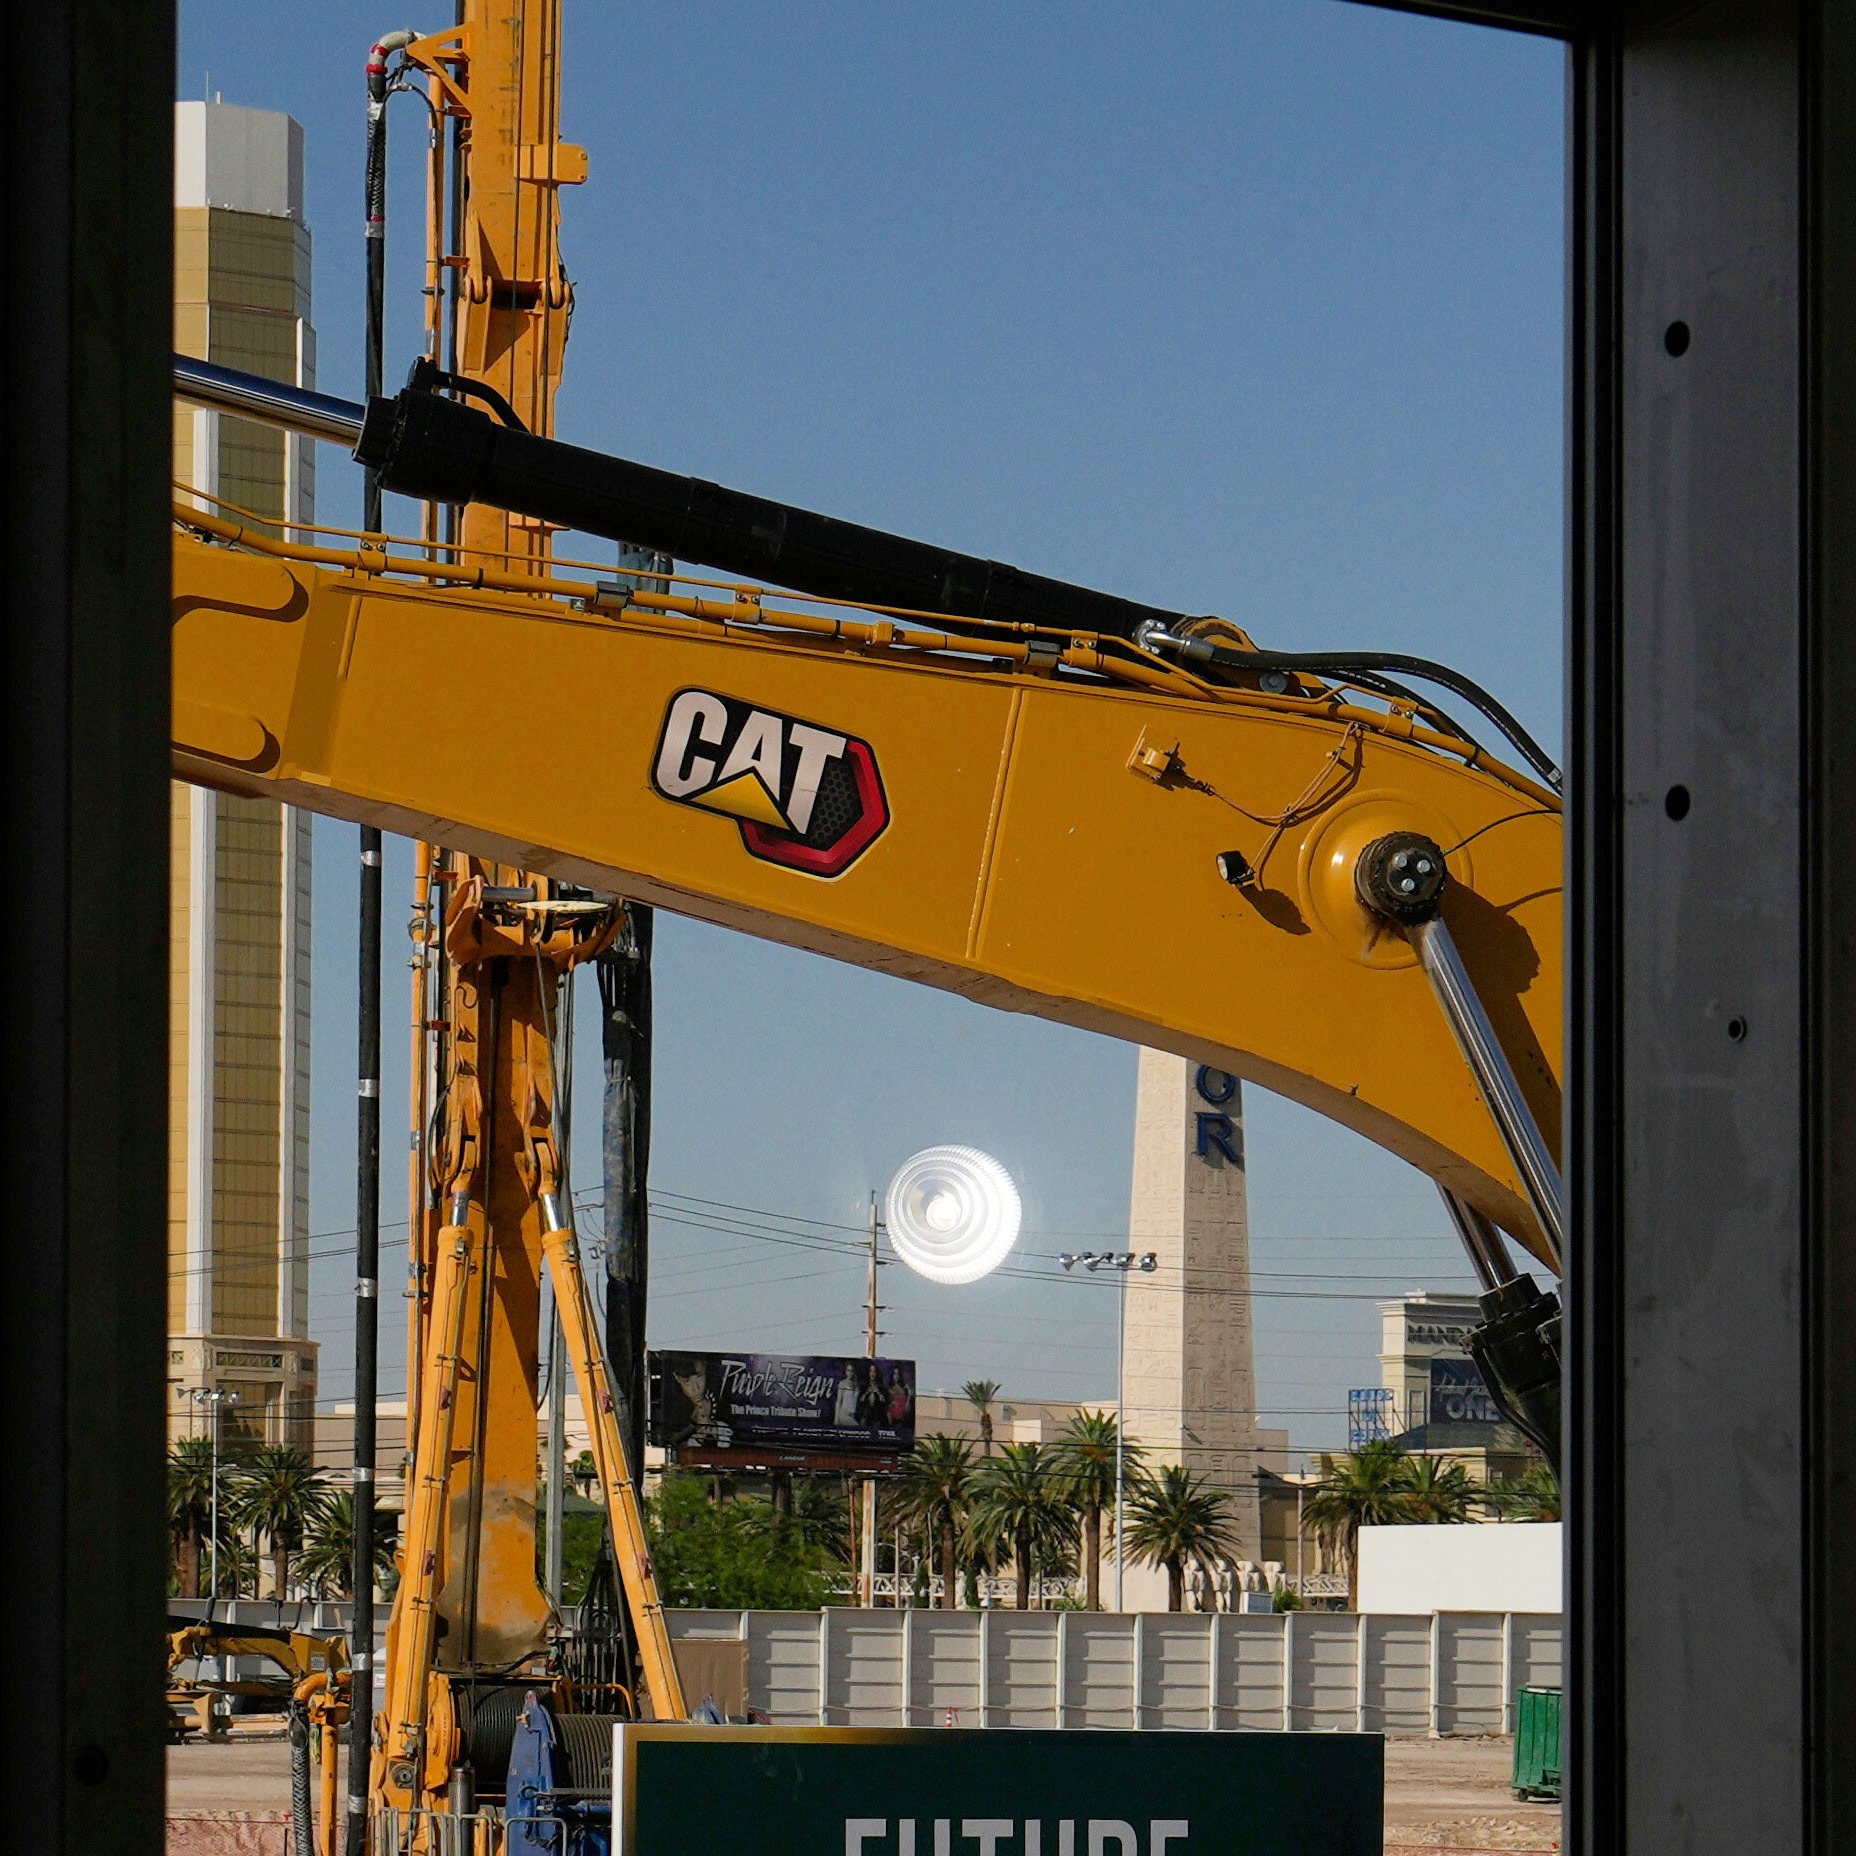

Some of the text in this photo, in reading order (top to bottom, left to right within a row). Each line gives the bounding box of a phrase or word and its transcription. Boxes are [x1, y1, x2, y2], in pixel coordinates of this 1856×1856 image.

[657, 692, 847, 834] CAT
[720, 1359, 835, 1406] Purple Reign
[731, 1404, 745, 1415] The
